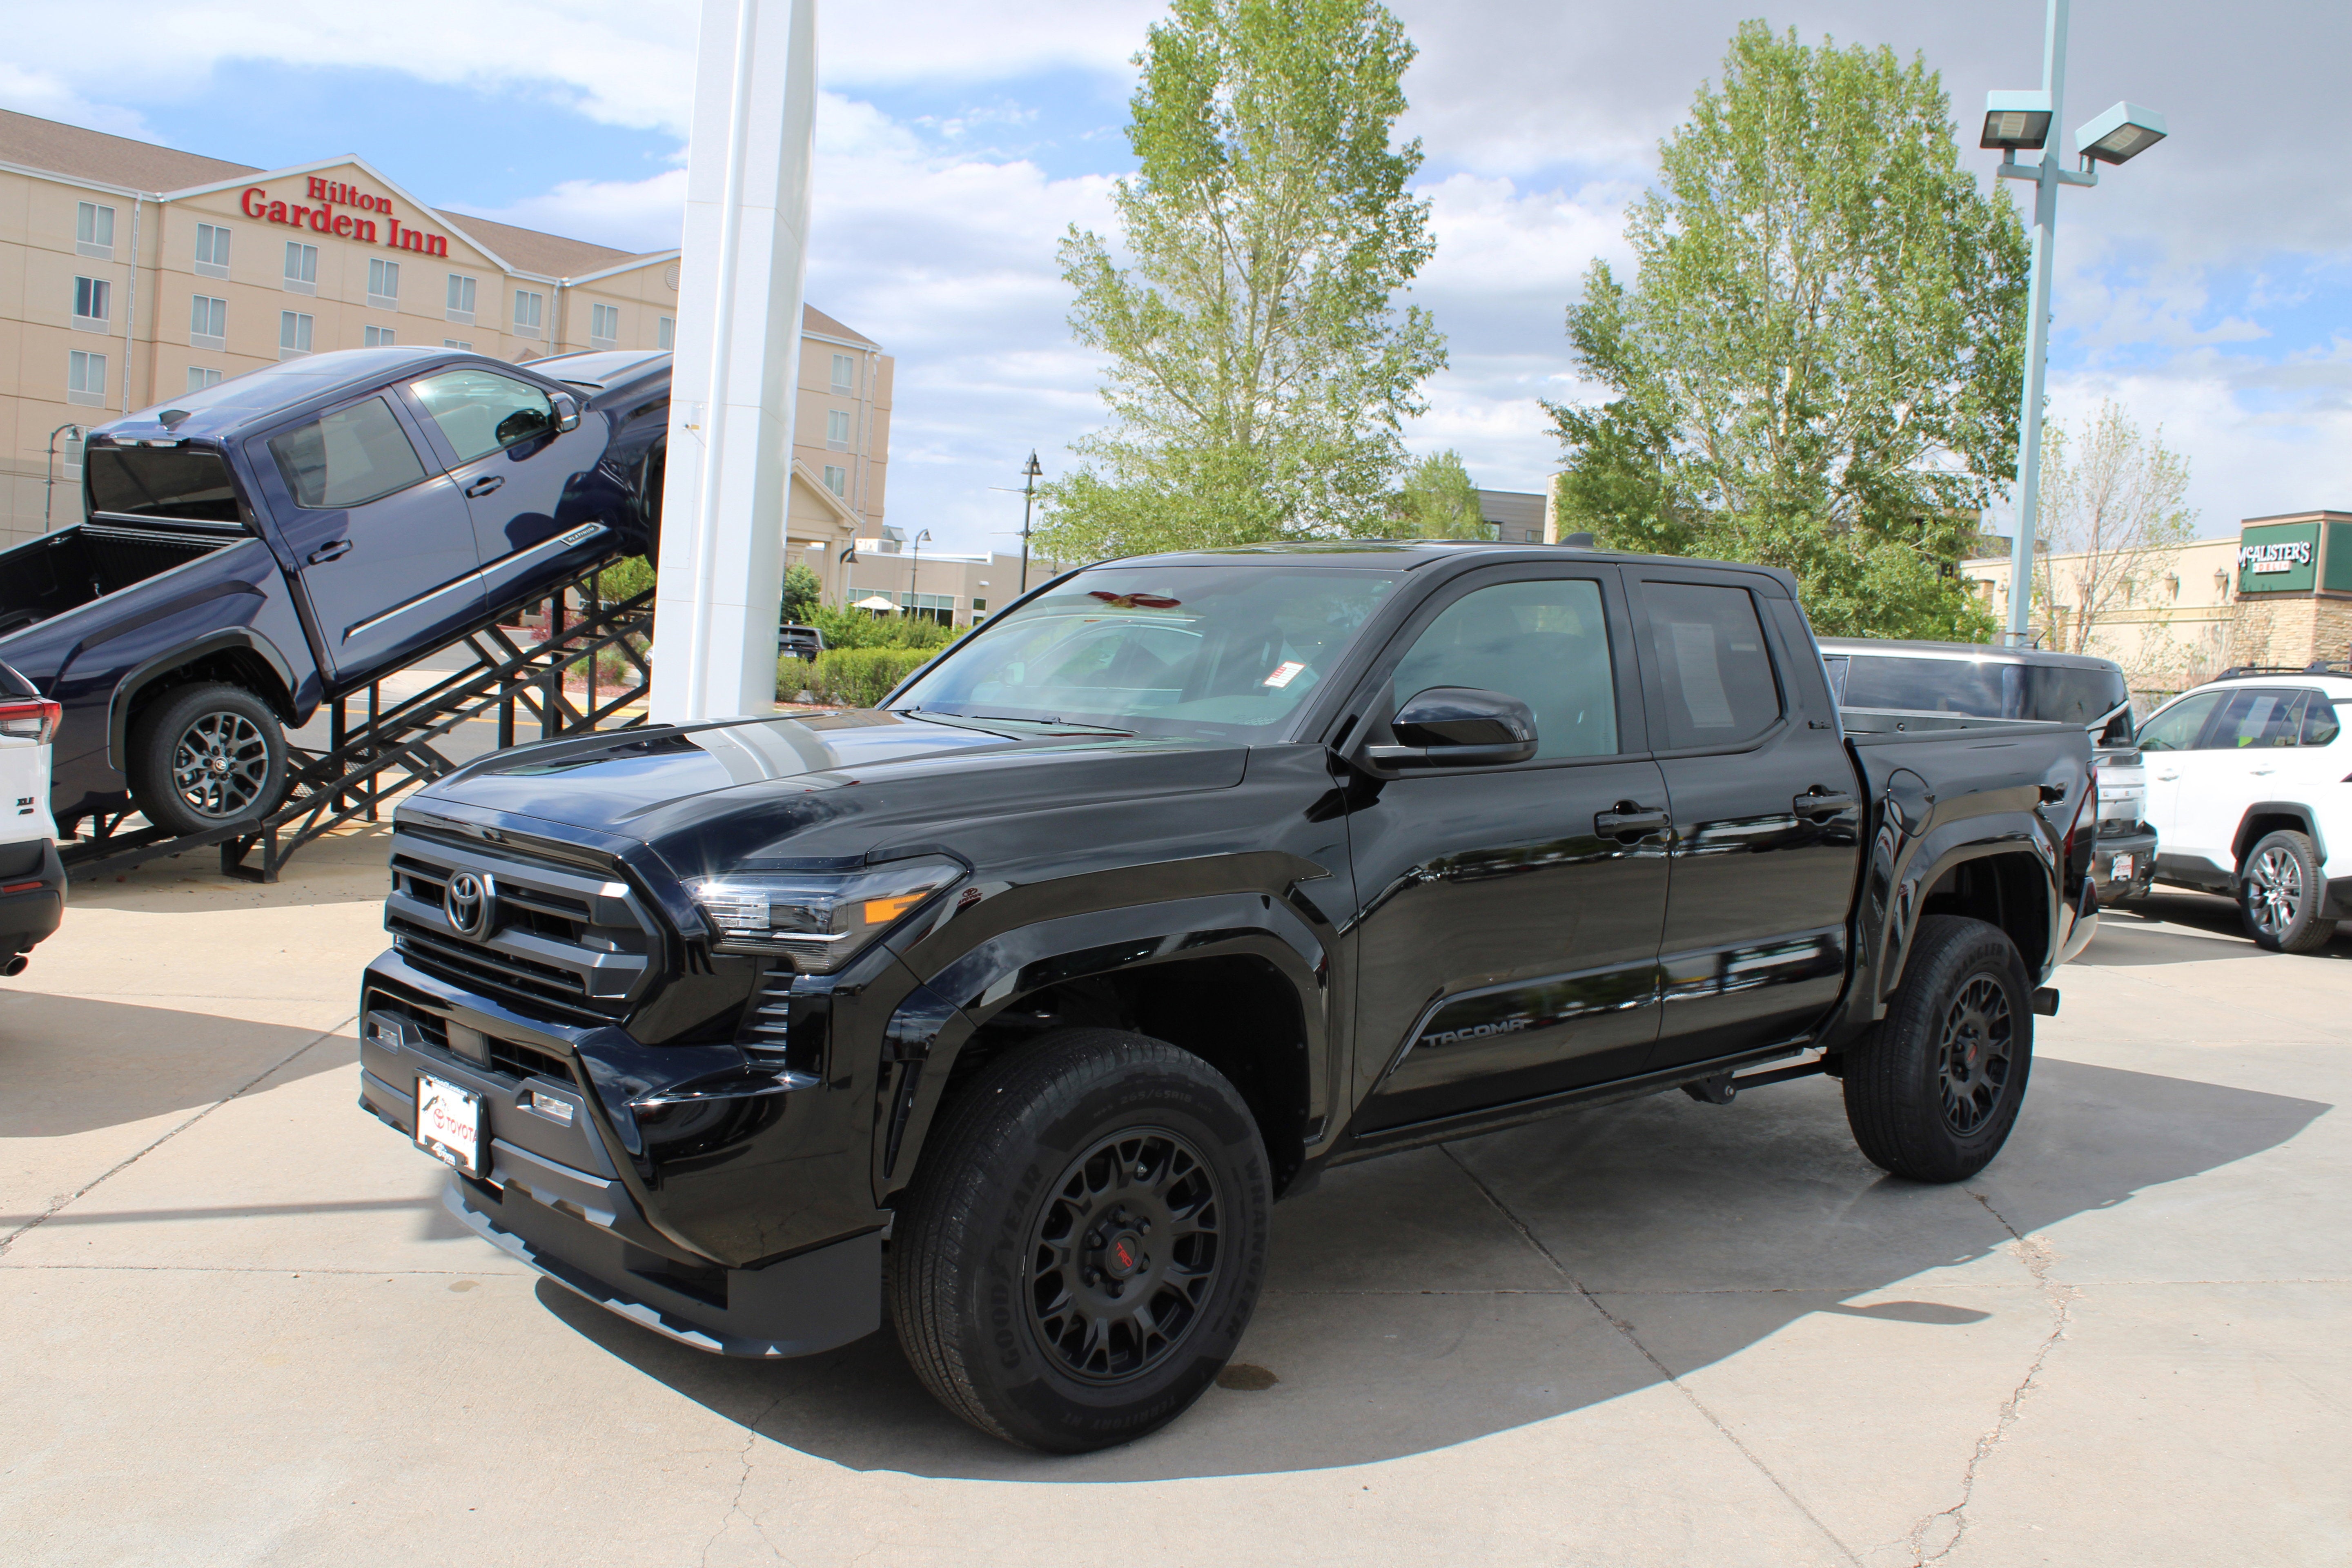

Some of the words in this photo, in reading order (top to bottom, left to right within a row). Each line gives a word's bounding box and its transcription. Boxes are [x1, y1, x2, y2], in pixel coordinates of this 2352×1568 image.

[307, 176, 393, 215] Hilton
[242, 187, 378, 243] Garden
[387, 218, 449, 258] Inn
[568, 526, 595, 541] PLATINUM
[2258, 562, 2282, 572] DELI
[1421, 1018, 1526, 1047] TACOMA
[446, 1116, 477, 1143] TOYOTA
[1116, 1241, 1134, 1267] TRD
[1225, 1155, 1266, 1341] WRANGLER
